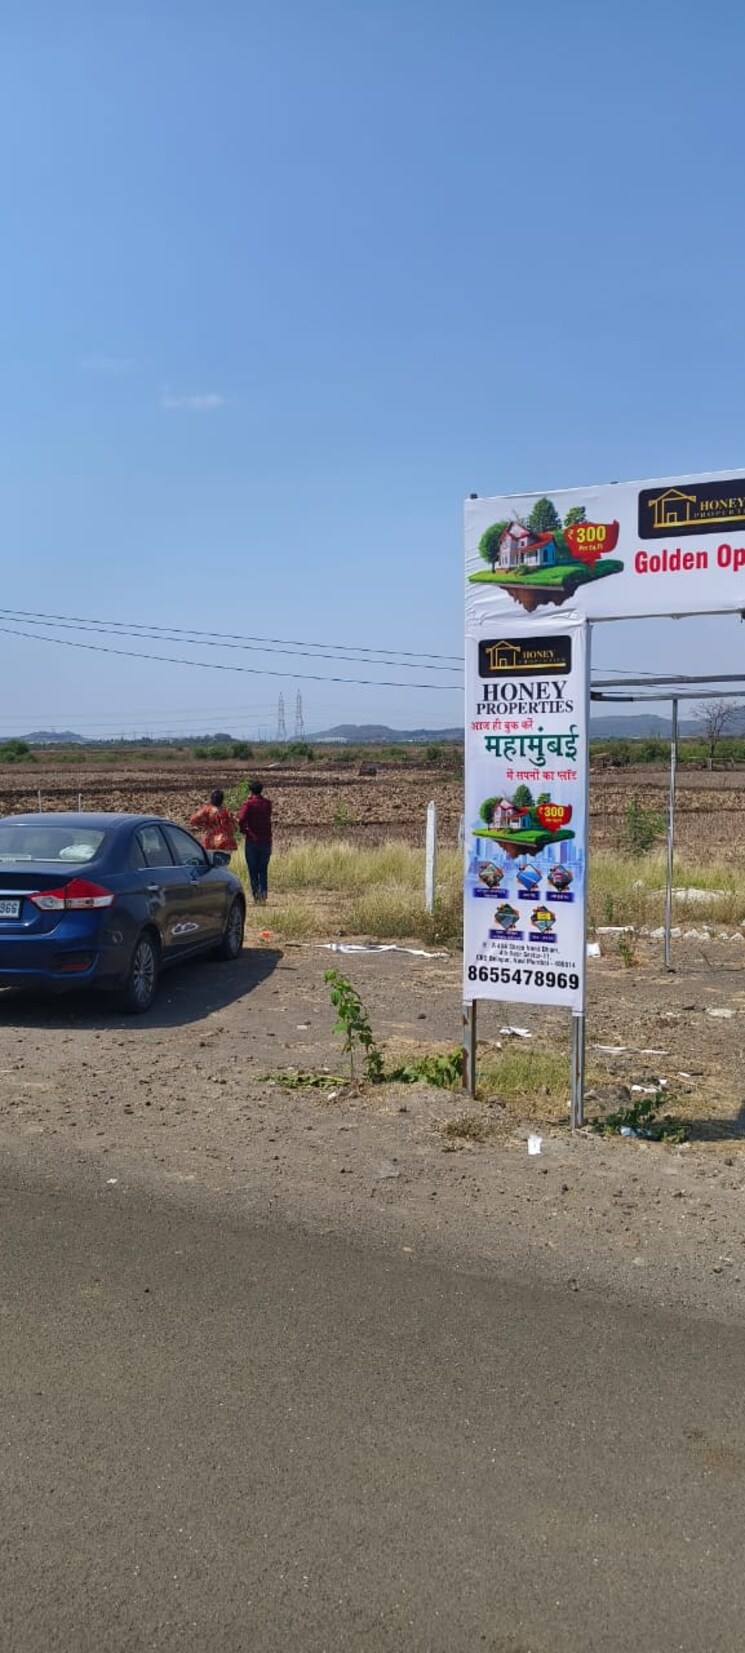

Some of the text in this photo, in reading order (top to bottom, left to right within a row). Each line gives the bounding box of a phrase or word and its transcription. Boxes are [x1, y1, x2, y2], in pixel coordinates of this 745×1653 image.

[700, 496, 745, 511] HONEY
[576, 524, 606, 543] 300
[635, 543, 745, 574] Golden Op
[522, 649, 554, 659] HONEY
[482, 680, 568, 702] HONEY
[476, 699, 574, 715] PROPERTIES
[471, 721, 490, 731] आज
[492, 718, 502, 730] ही
[504, 721, 519, 734] बुक
[484, 724, 579, 767] महामुंबई
[542, 770, 555, 781] का
[544, 806, 564, 817] 300
[468, 965, 580, 990] 8655478969
